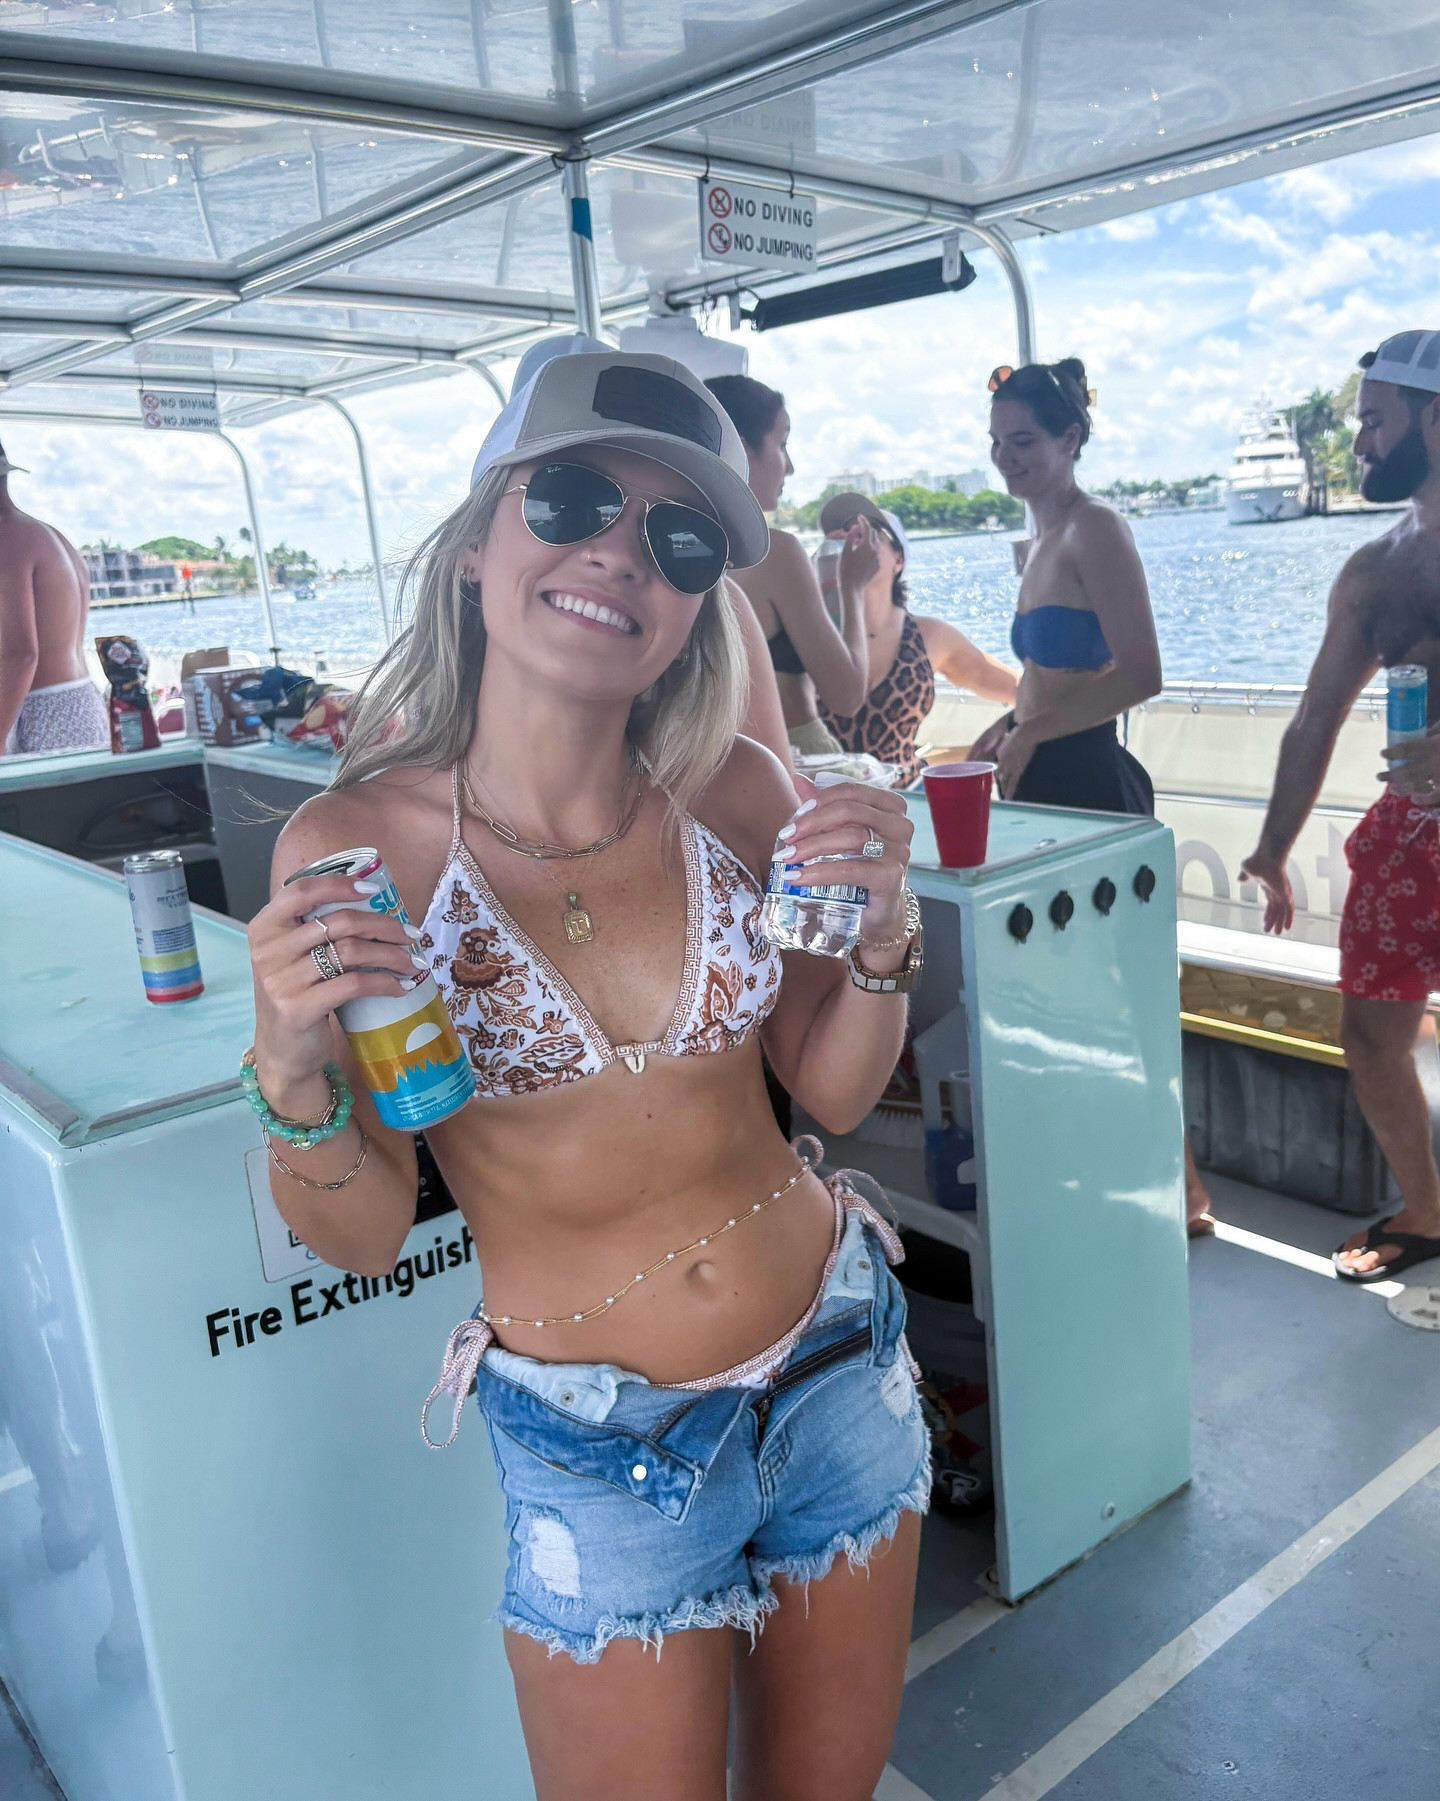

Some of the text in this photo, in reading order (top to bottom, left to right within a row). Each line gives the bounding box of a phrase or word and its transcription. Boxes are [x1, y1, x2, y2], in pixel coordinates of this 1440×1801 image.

[734, 198, 813, 227] NO DIVING
[734, 232, 813, 261] NO JUMPING
[161, 398, 216, 410] NO DIVING
[163, 415, 218, 428] NO JUMPING
[206, 1306, 283, 1357] Fire
